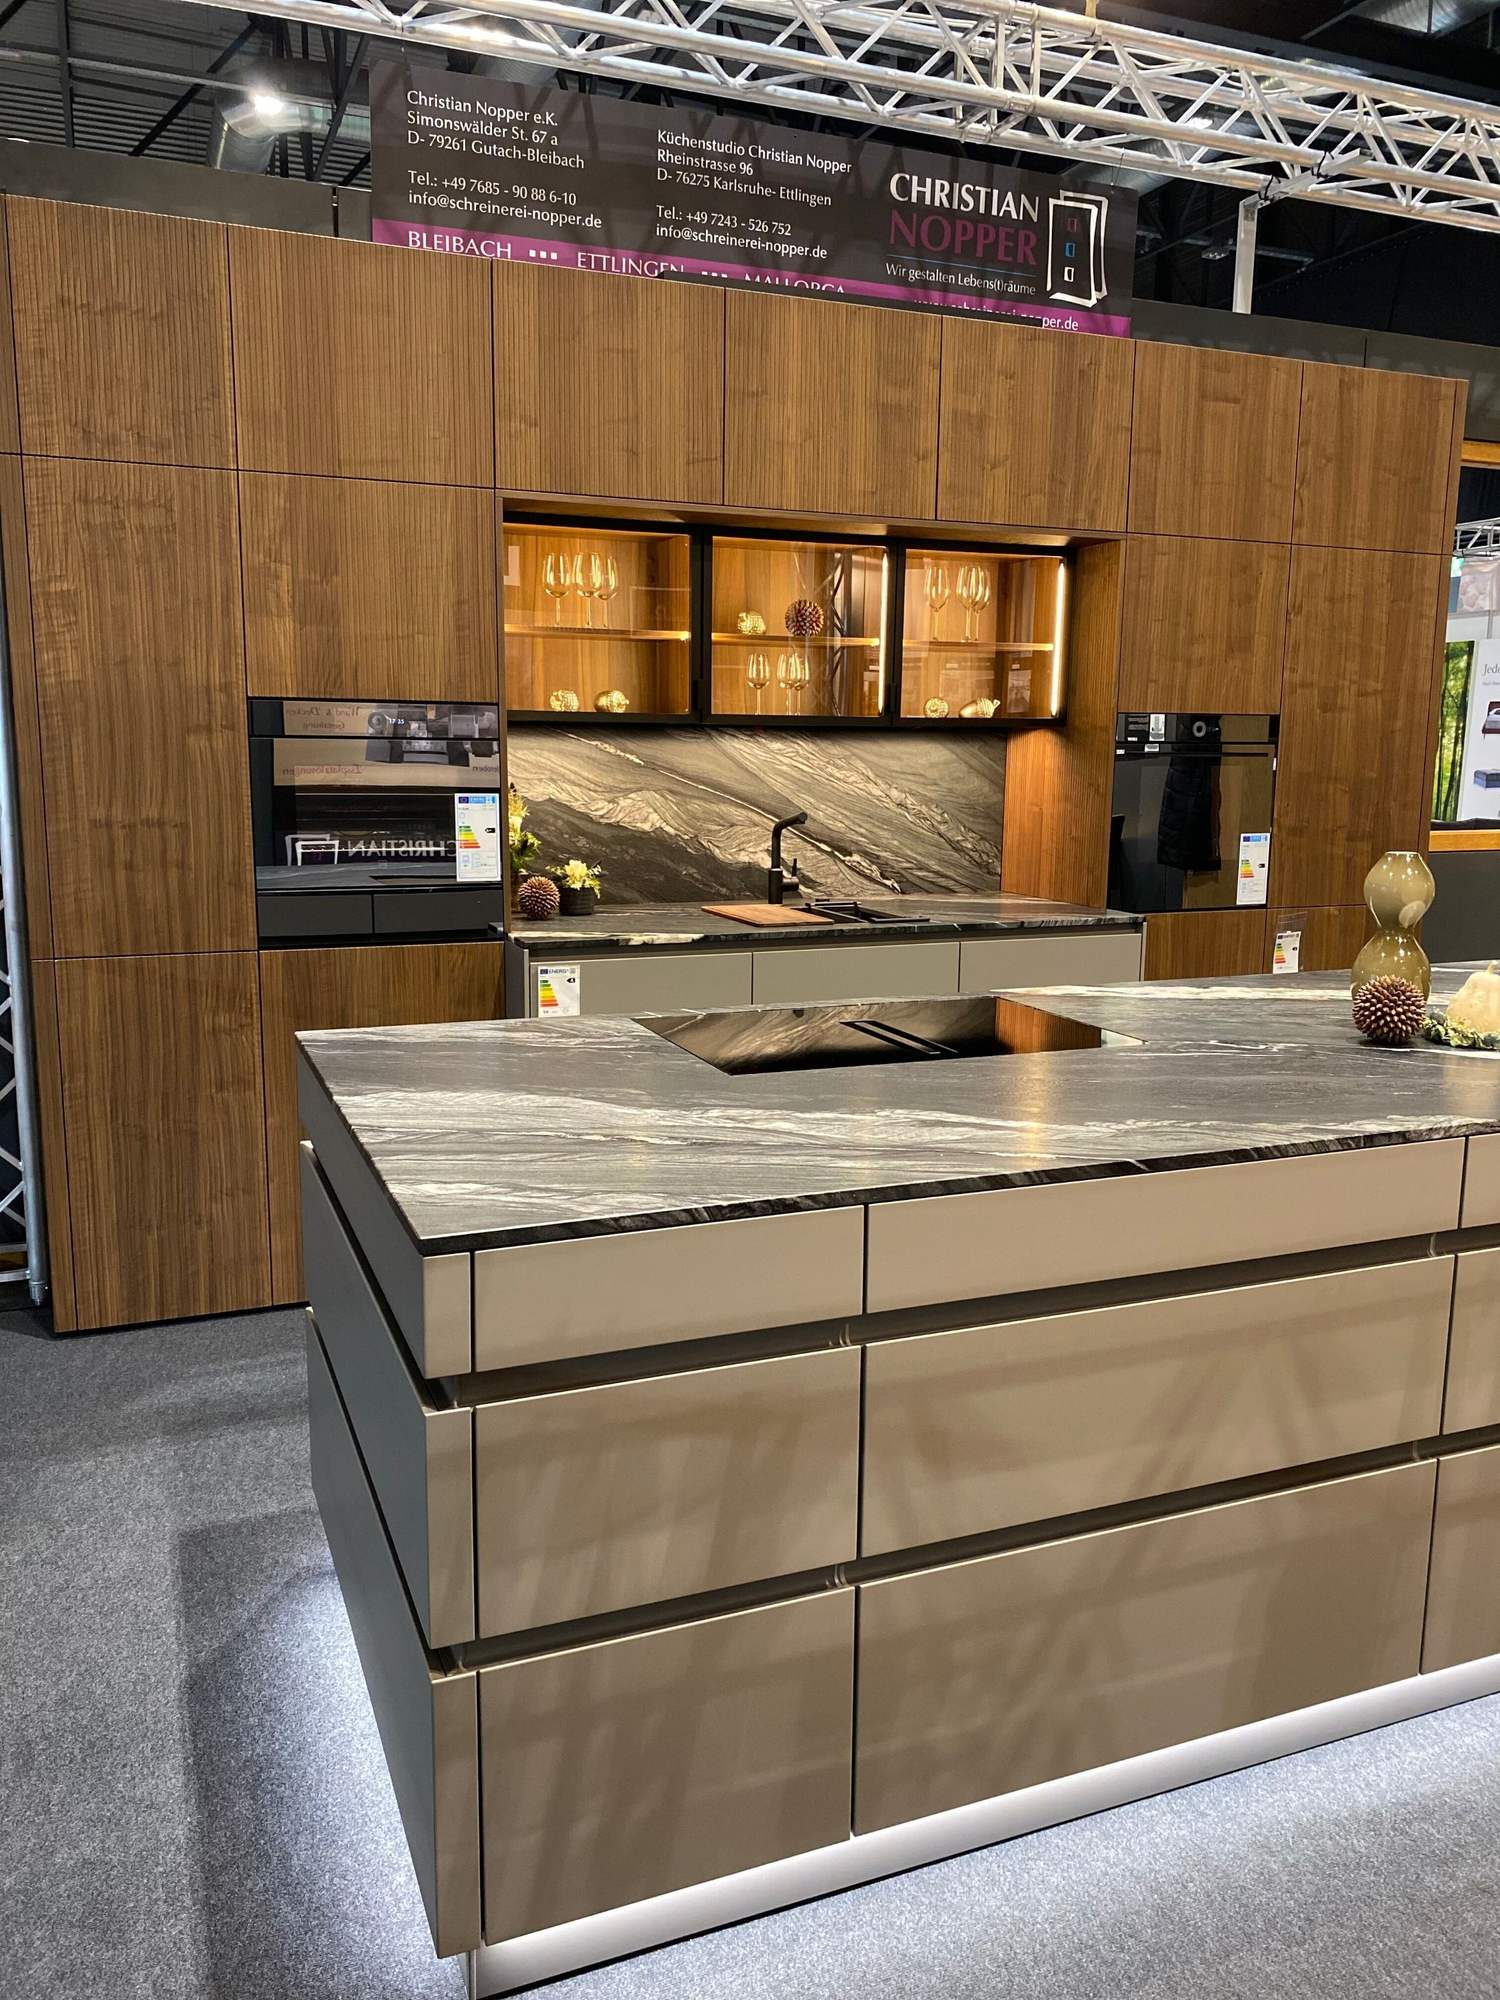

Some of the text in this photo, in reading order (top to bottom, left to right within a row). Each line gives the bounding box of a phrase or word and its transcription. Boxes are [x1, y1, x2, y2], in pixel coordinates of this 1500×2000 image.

[407, 90, 558, 126] Christian Nopper e.K.
[407, 111, 558, 145] Simonswälder St. 67 a
[407, 130, 585, 169] D- 79261 Gutach-Bleibach
[657, 129, 851, 174] Küchenstudio Christian Nopper
[657, 149, 753, 175] Rheinstrasse 96
[408, 170, 437, 187] Tel.:
[442, 176, 466, 190] +49
[470, 179, 500, 195] 7685
[512, 185, 528, 199] 90
[531, 188, 546, 202] 88
[549, 191, 577, 206] 6-10
[657, 168, 831, 207] D- 76275 Karlsruhe- Ettlingen
[889, 173, 1039, 222] CHRISTIAN
[409, 190, 602, 229] info@schreinerei-nopper.de
[656, 205, 682, 220] Tel.:
[686, 211, 708, 224] +49
[710, 213, 737, 228] 7243
[748, 218, 769, 233] 526
[772, 222, 791, 236] 752
[408, 231, 512, 259] BLEIBACH
[656, 224, 828, 258] info@schreinerei-nopper.de
[889, 209, 1037, 265] NOPPER
[885, 263, 1036, 296] Wir gestalten Lebens(t)räume
